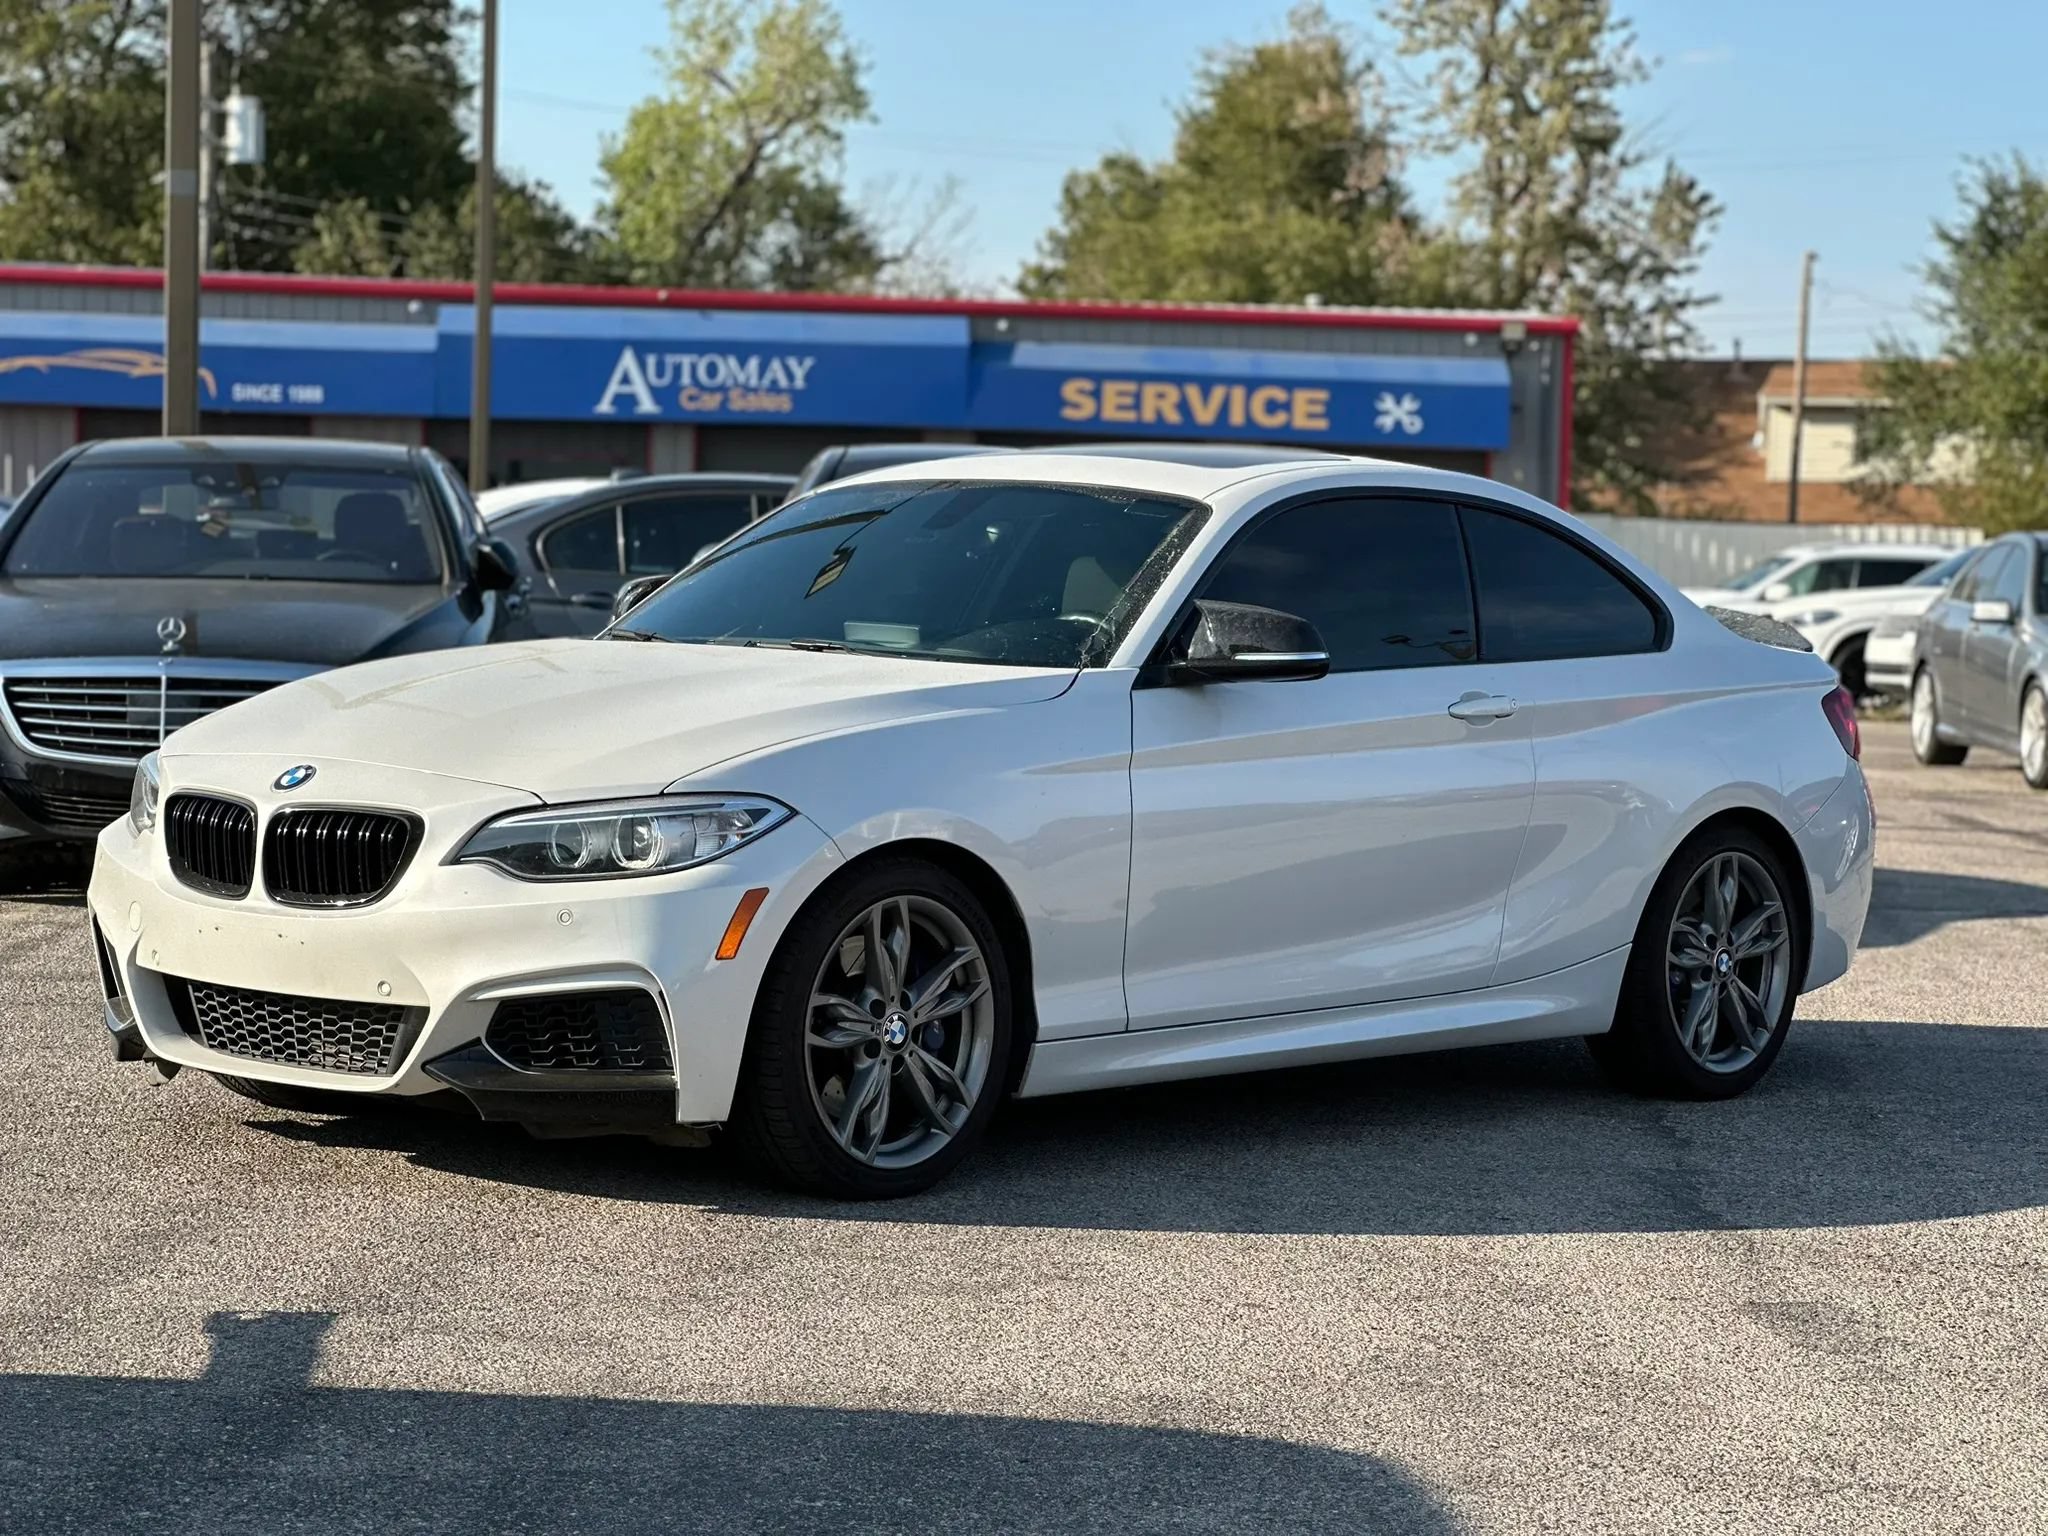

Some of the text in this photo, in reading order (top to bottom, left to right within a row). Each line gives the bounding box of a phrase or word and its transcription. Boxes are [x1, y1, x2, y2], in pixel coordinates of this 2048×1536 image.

[231, 382, 283, 403] SINCE
[593, 345, 815, 414] AUTOMAY
[679, 385, 793, 413] Car Sales
[1059, 377, 1331, 431] SERVICE
